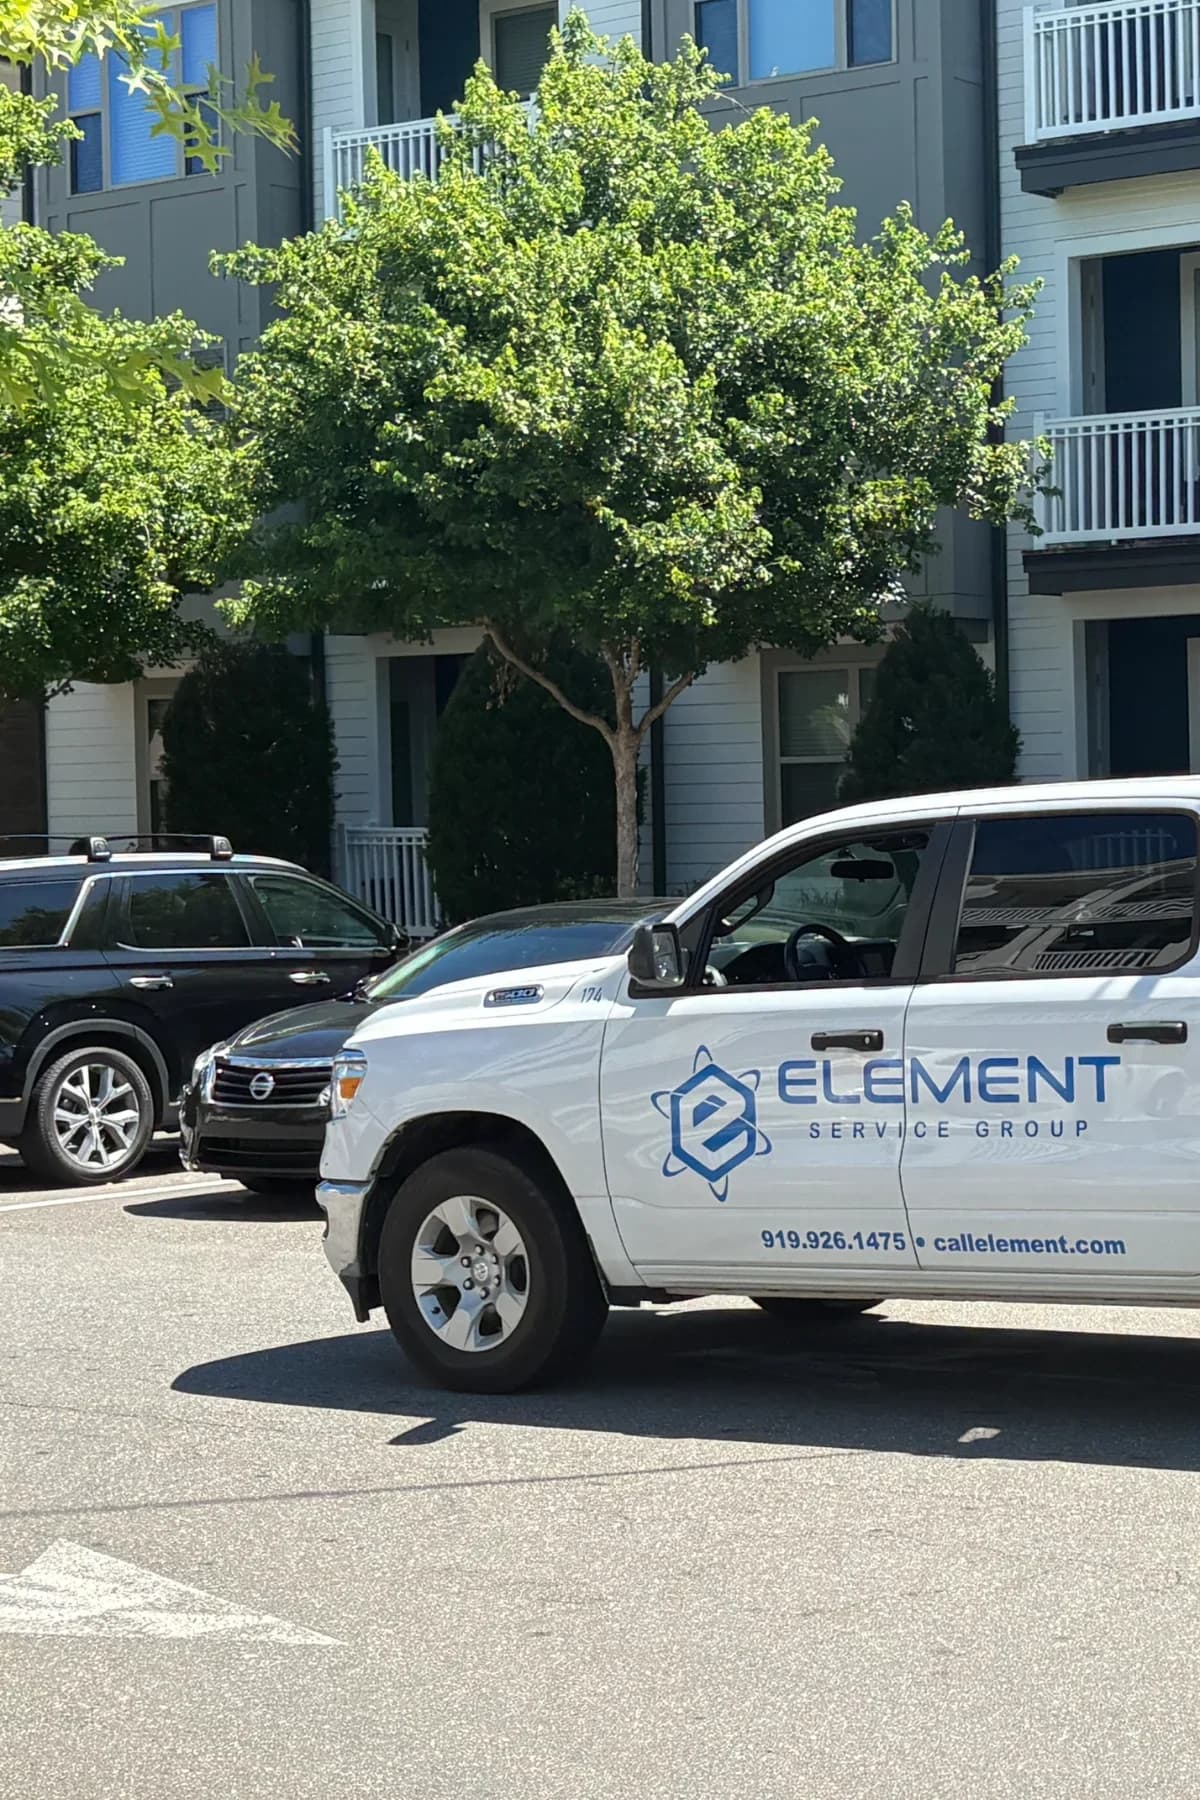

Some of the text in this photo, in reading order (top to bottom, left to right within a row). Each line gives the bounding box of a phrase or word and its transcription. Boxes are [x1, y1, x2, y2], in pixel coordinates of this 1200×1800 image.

[778, 1056, 1121, 1104] ELEMENT
[808, 1119, 1090, 1139] SERVICE GROUP
[761, 1230, 1126, 1255] 919.926.1475 callelement.com
